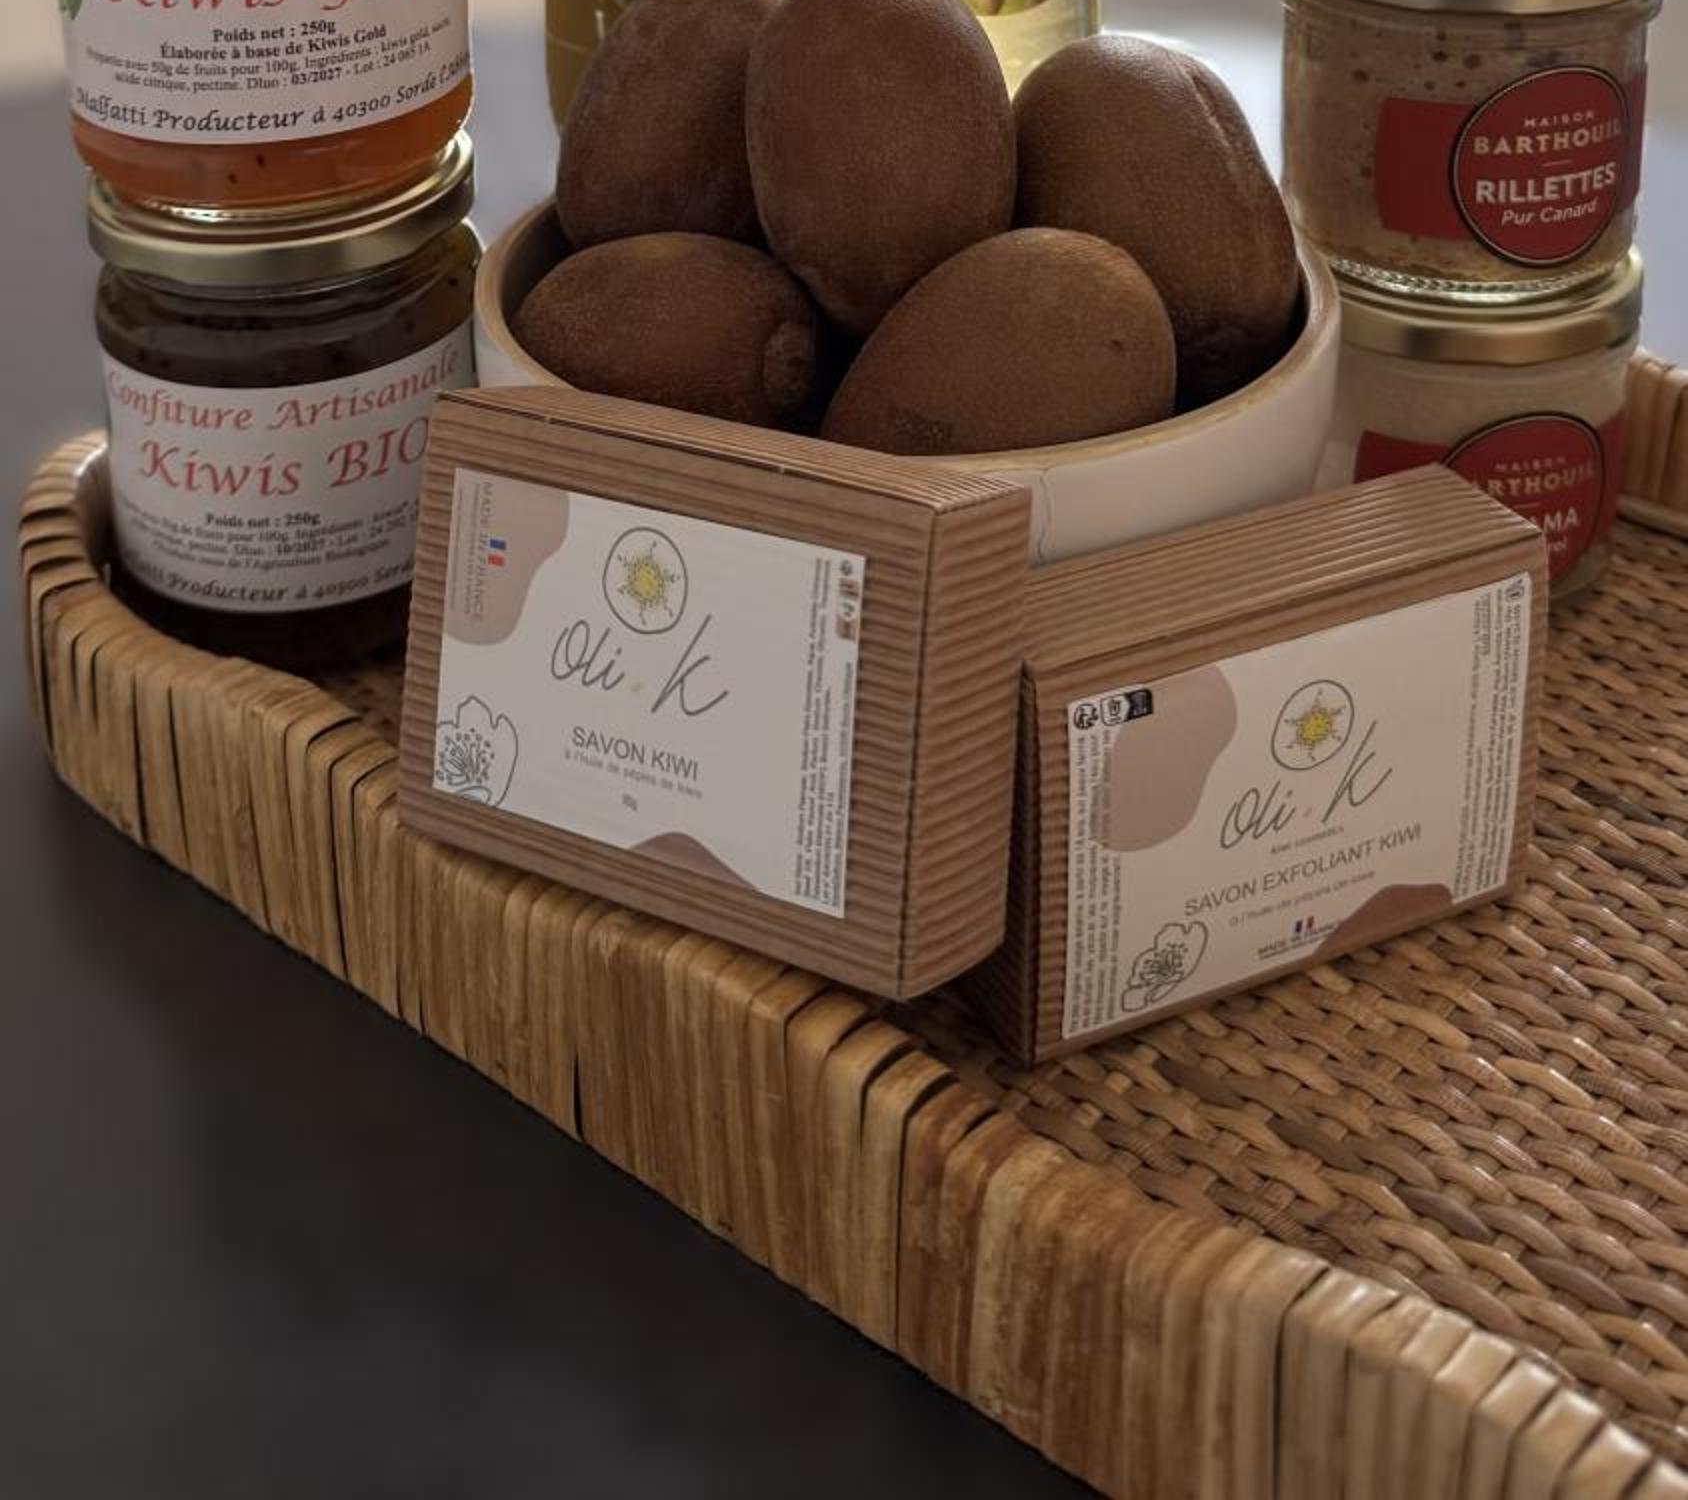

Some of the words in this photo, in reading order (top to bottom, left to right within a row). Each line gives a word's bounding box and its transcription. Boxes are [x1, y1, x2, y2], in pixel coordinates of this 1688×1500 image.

[160, 42, 227, 61] Élaborée
[231, 45, 241, 59] à
[245, 45, 280, 60] base
[285, 41, 305, 55] de
[308, 34, 350, 53] Kiwis
[353, 24, 387, 44] Gold
[212, 29, 256, 43] Poids
[260, 26, 285, 40] net
[300, 19, 336, 35] 250g
[153, 108, 304, 133] Producteur
[312, 105, 326, 125] à
[332, 94, 391, 122] 40300
[1523, 110, 1595, 129] MAISON
[1473, 118, 1622, 155] BARTHOUIL
[1475, 161, 1617, 205] RILLETTES
[1501, 208, 1536, 227] Pur
[1539, 195, 1599, 224] Canard
[108, 371, 252, 431] Confiture
[266, 342, 459, 430] Artisanale
[139, 440, 303, 496] Kiwis
[326, 415, 430, 488] BIO
[166, 571, 289, 602] Producteur
[571, 725, 646, 765] SAVON
[651, 750, 699, 782] KIWI
[1183, 878, 1258, 918] SAVON
[1262, 837, 1376, 892] EXFOLIANT
[1378, 822, 1422, 853] KIWI
